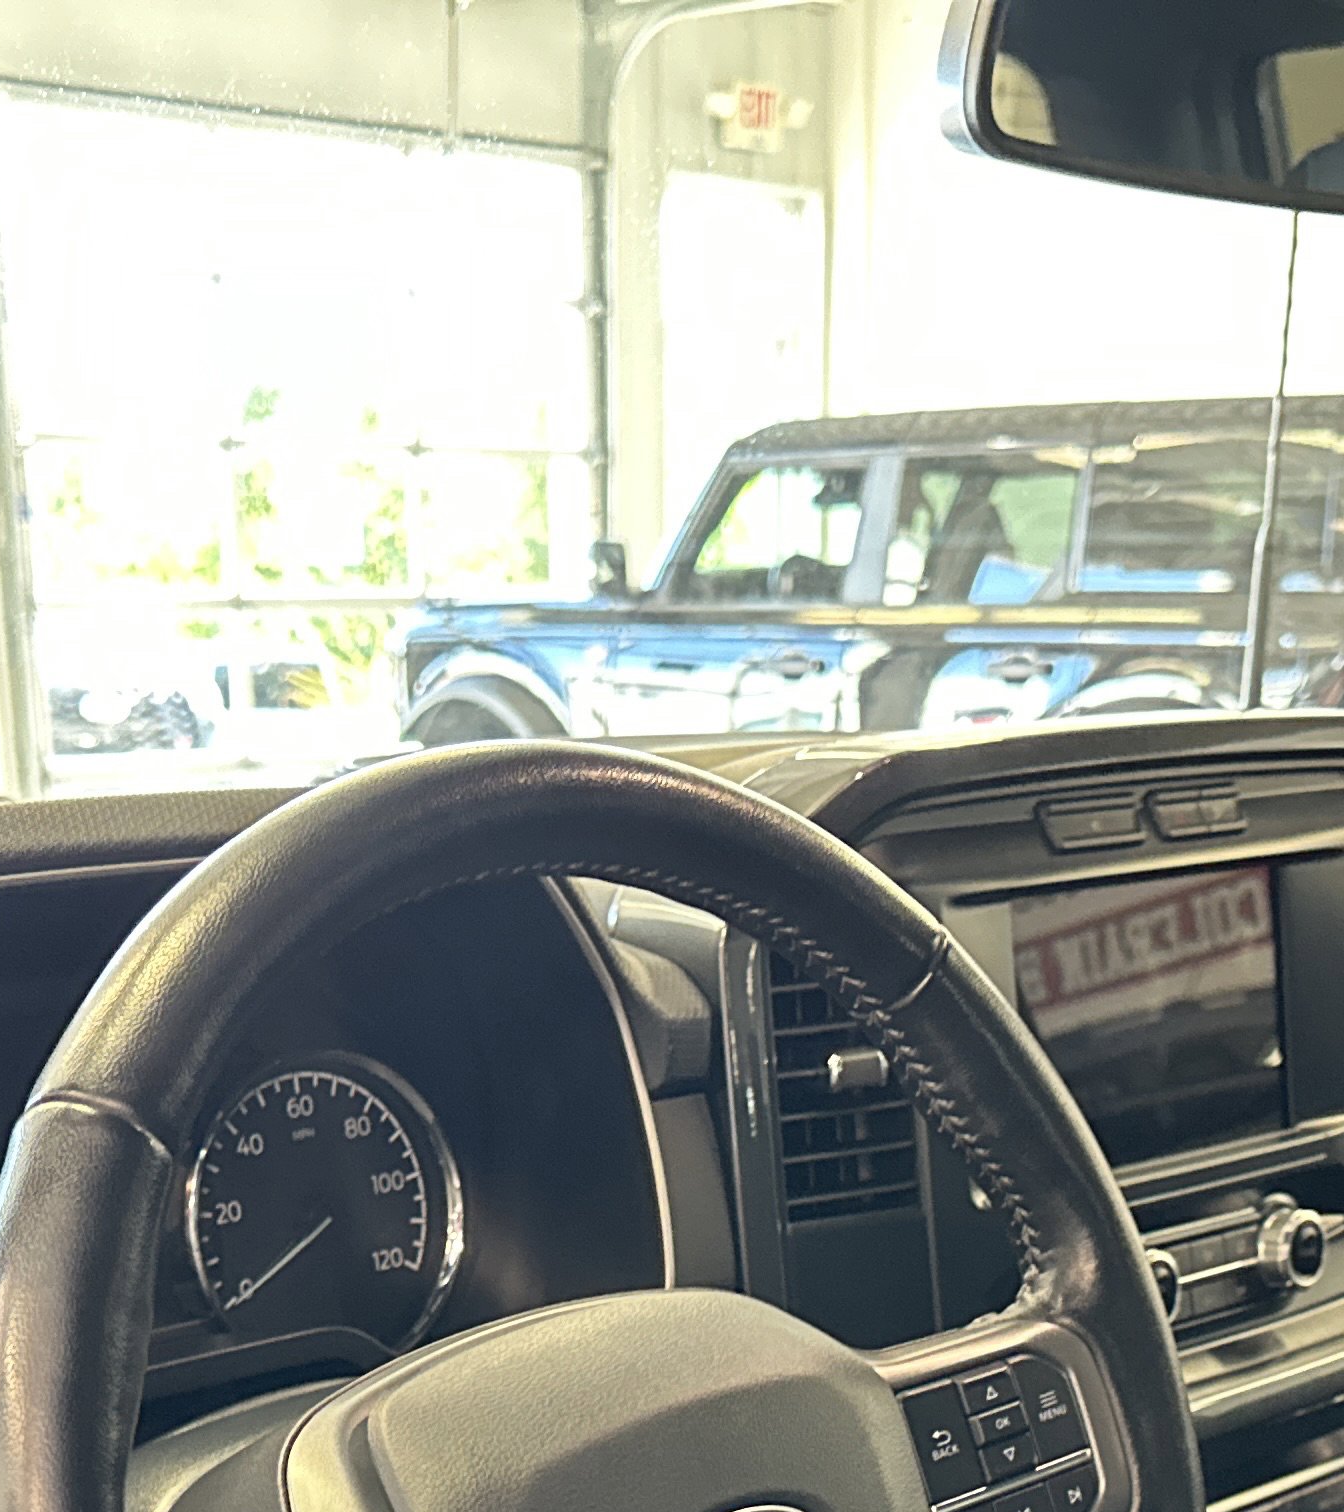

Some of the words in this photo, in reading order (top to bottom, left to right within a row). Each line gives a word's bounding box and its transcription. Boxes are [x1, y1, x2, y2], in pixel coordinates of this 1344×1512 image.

[286, 1095, 314, 1119] 60
[343, 1115, 372, 1139] 80
[236, 1133, 264, 1156] 40
[370, 1171, 405, 1195] 100
[215, 1200, 242, 1225] 20
[371, 1247, 404, 1272] 120
[995, 1417, 1011, 1430] OK
[1038, 1405, 1067, 1423] MENU
[931, 1444, 960, 1462] BACK
